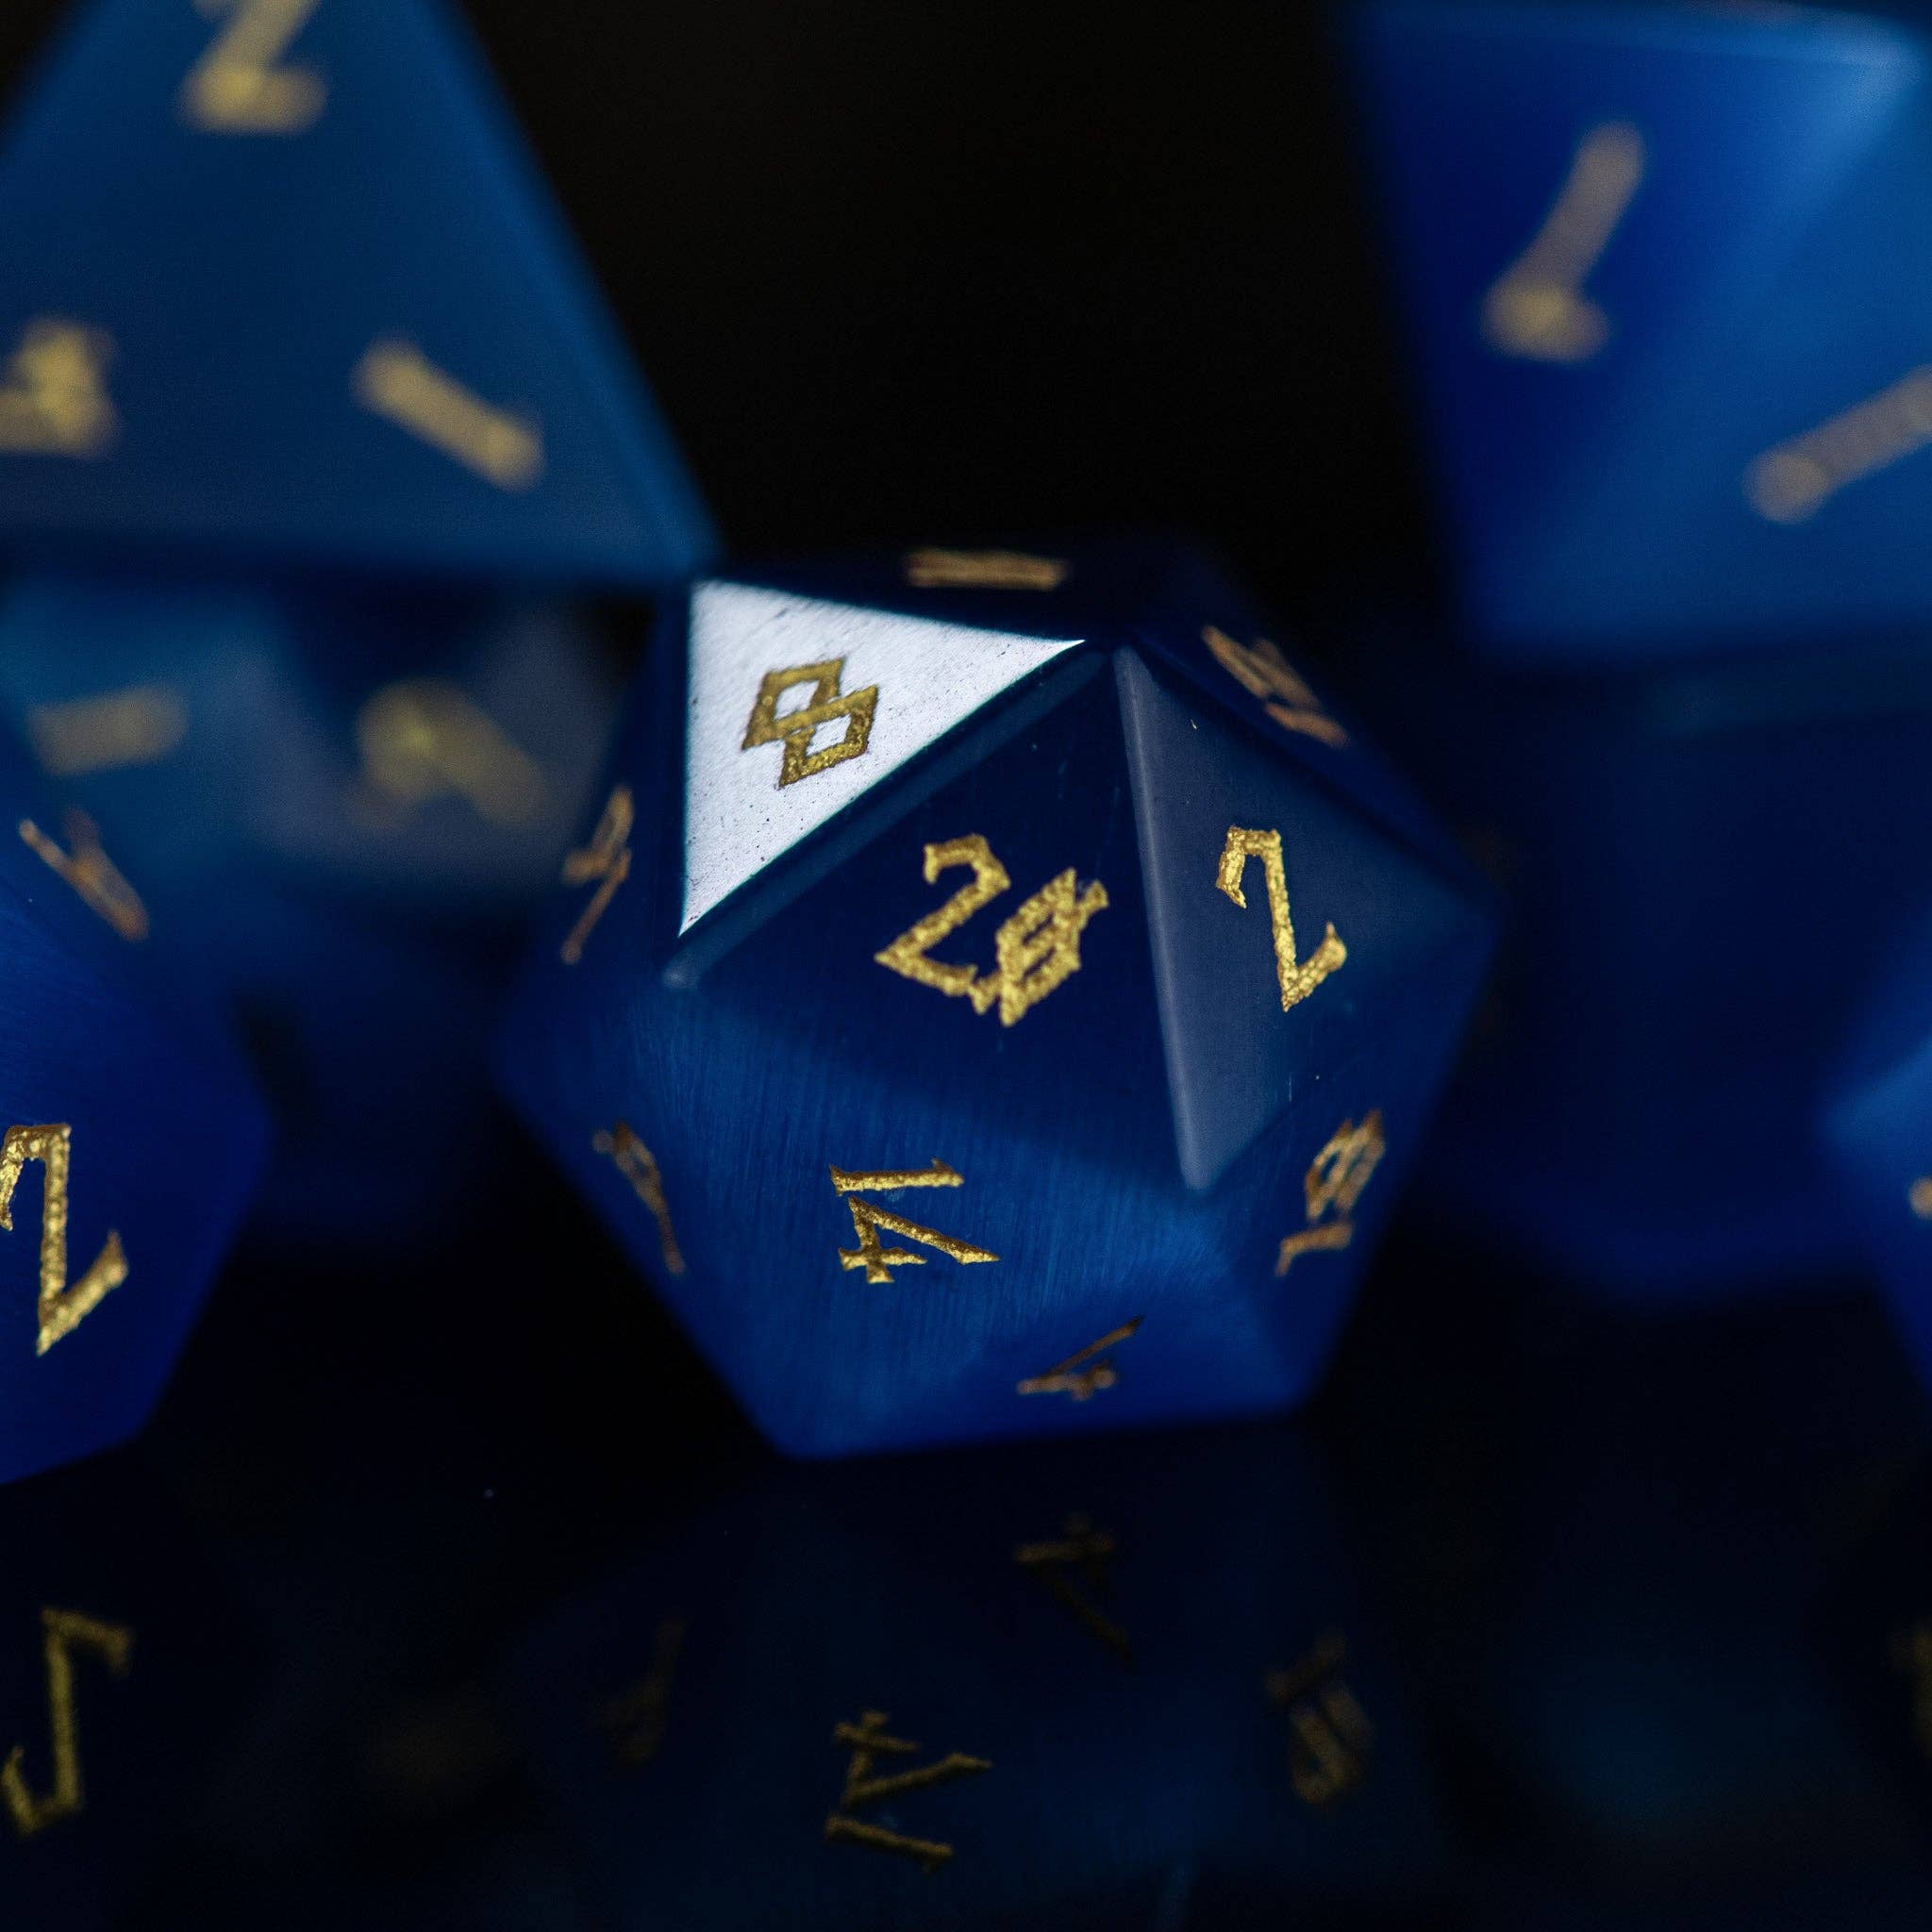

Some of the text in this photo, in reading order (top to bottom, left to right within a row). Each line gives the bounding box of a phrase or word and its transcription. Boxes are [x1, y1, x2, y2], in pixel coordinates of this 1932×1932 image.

[874, 831, 1109, 1027] 20
[1216, 825, 1346, 1012] 2
[830, 1158, 1001, 1284] 14
